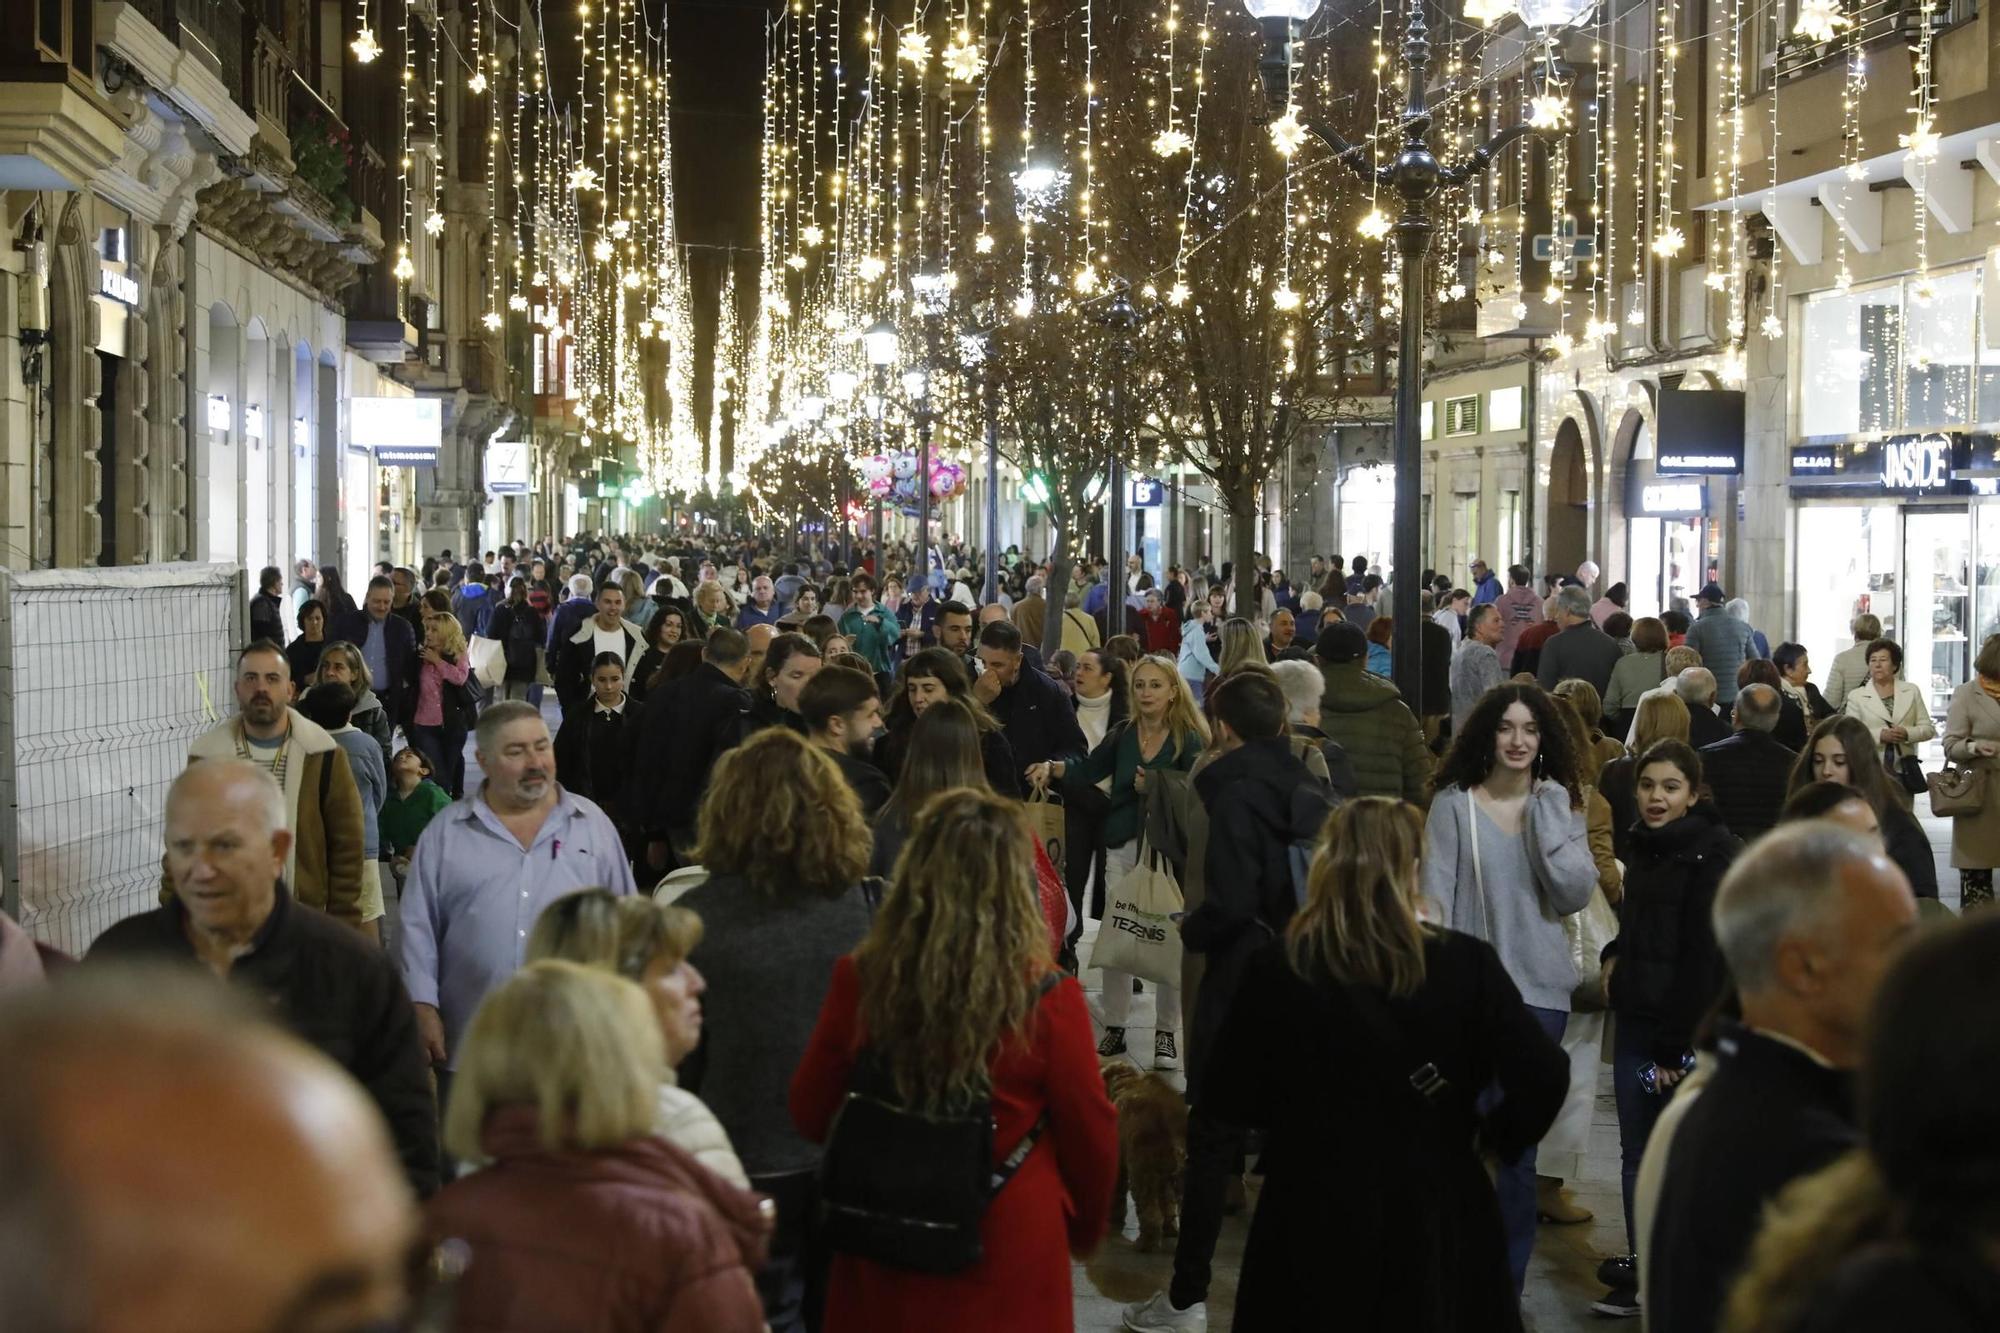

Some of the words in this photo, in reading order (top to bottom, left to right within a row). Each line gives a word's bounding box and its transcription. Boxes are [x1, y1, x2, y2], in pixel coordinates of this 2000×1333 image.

[1660, 455, 1736, 468] CALZEDONIA
[1885, 439, 1947, 488] INSIDE
[1115, 900, 1127, 910] be
